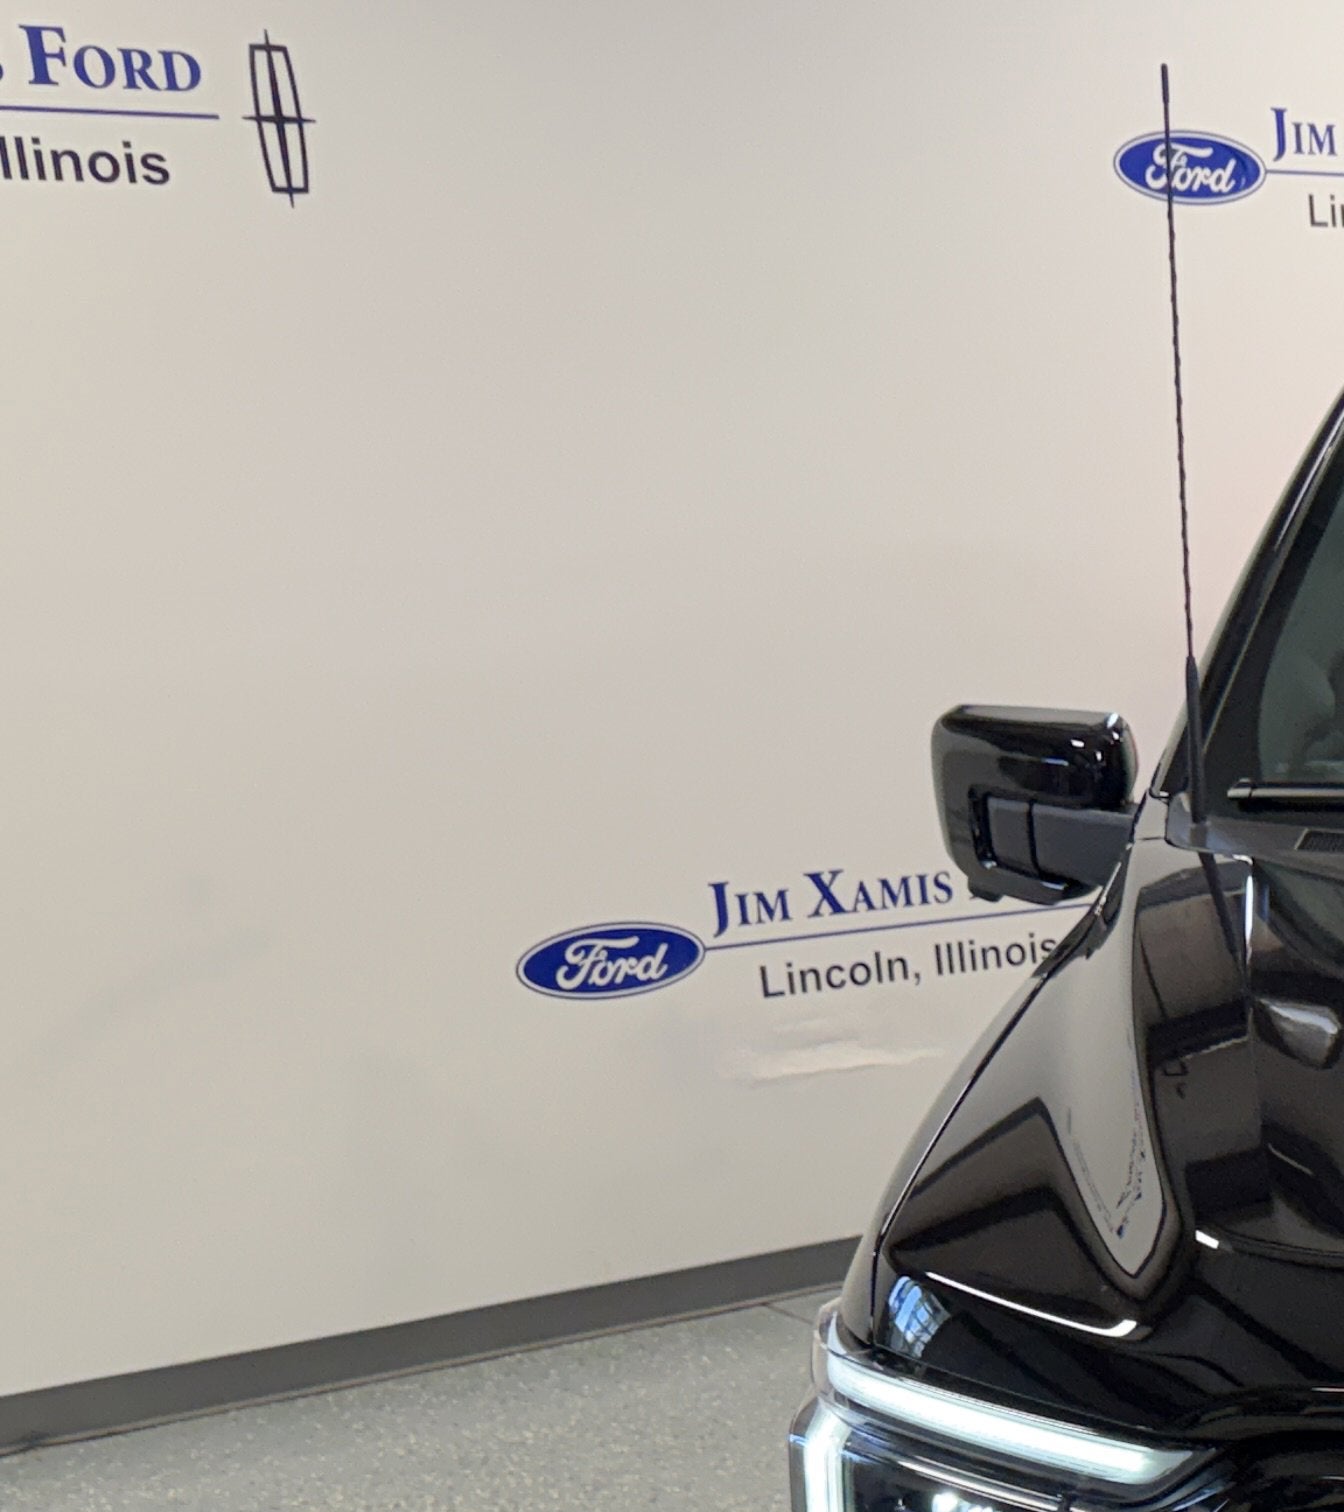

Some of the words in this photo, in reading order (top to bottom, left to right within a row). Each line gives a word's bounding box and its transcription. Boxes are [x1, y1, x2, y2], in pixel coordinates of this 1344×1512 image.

[18, 24, 201, 92] FORD
[0, 135, 171, 186] llinois
[1270, 106, 1338, 163] JIM
[1145, 142, 1237, 193] Ford
[707, 881, 793, 939] JIM
[802, 868, 954, 919] XAMIS
[557, 936, 668, 990] Ford
[759, 950, 922, 999] Lincoln,
